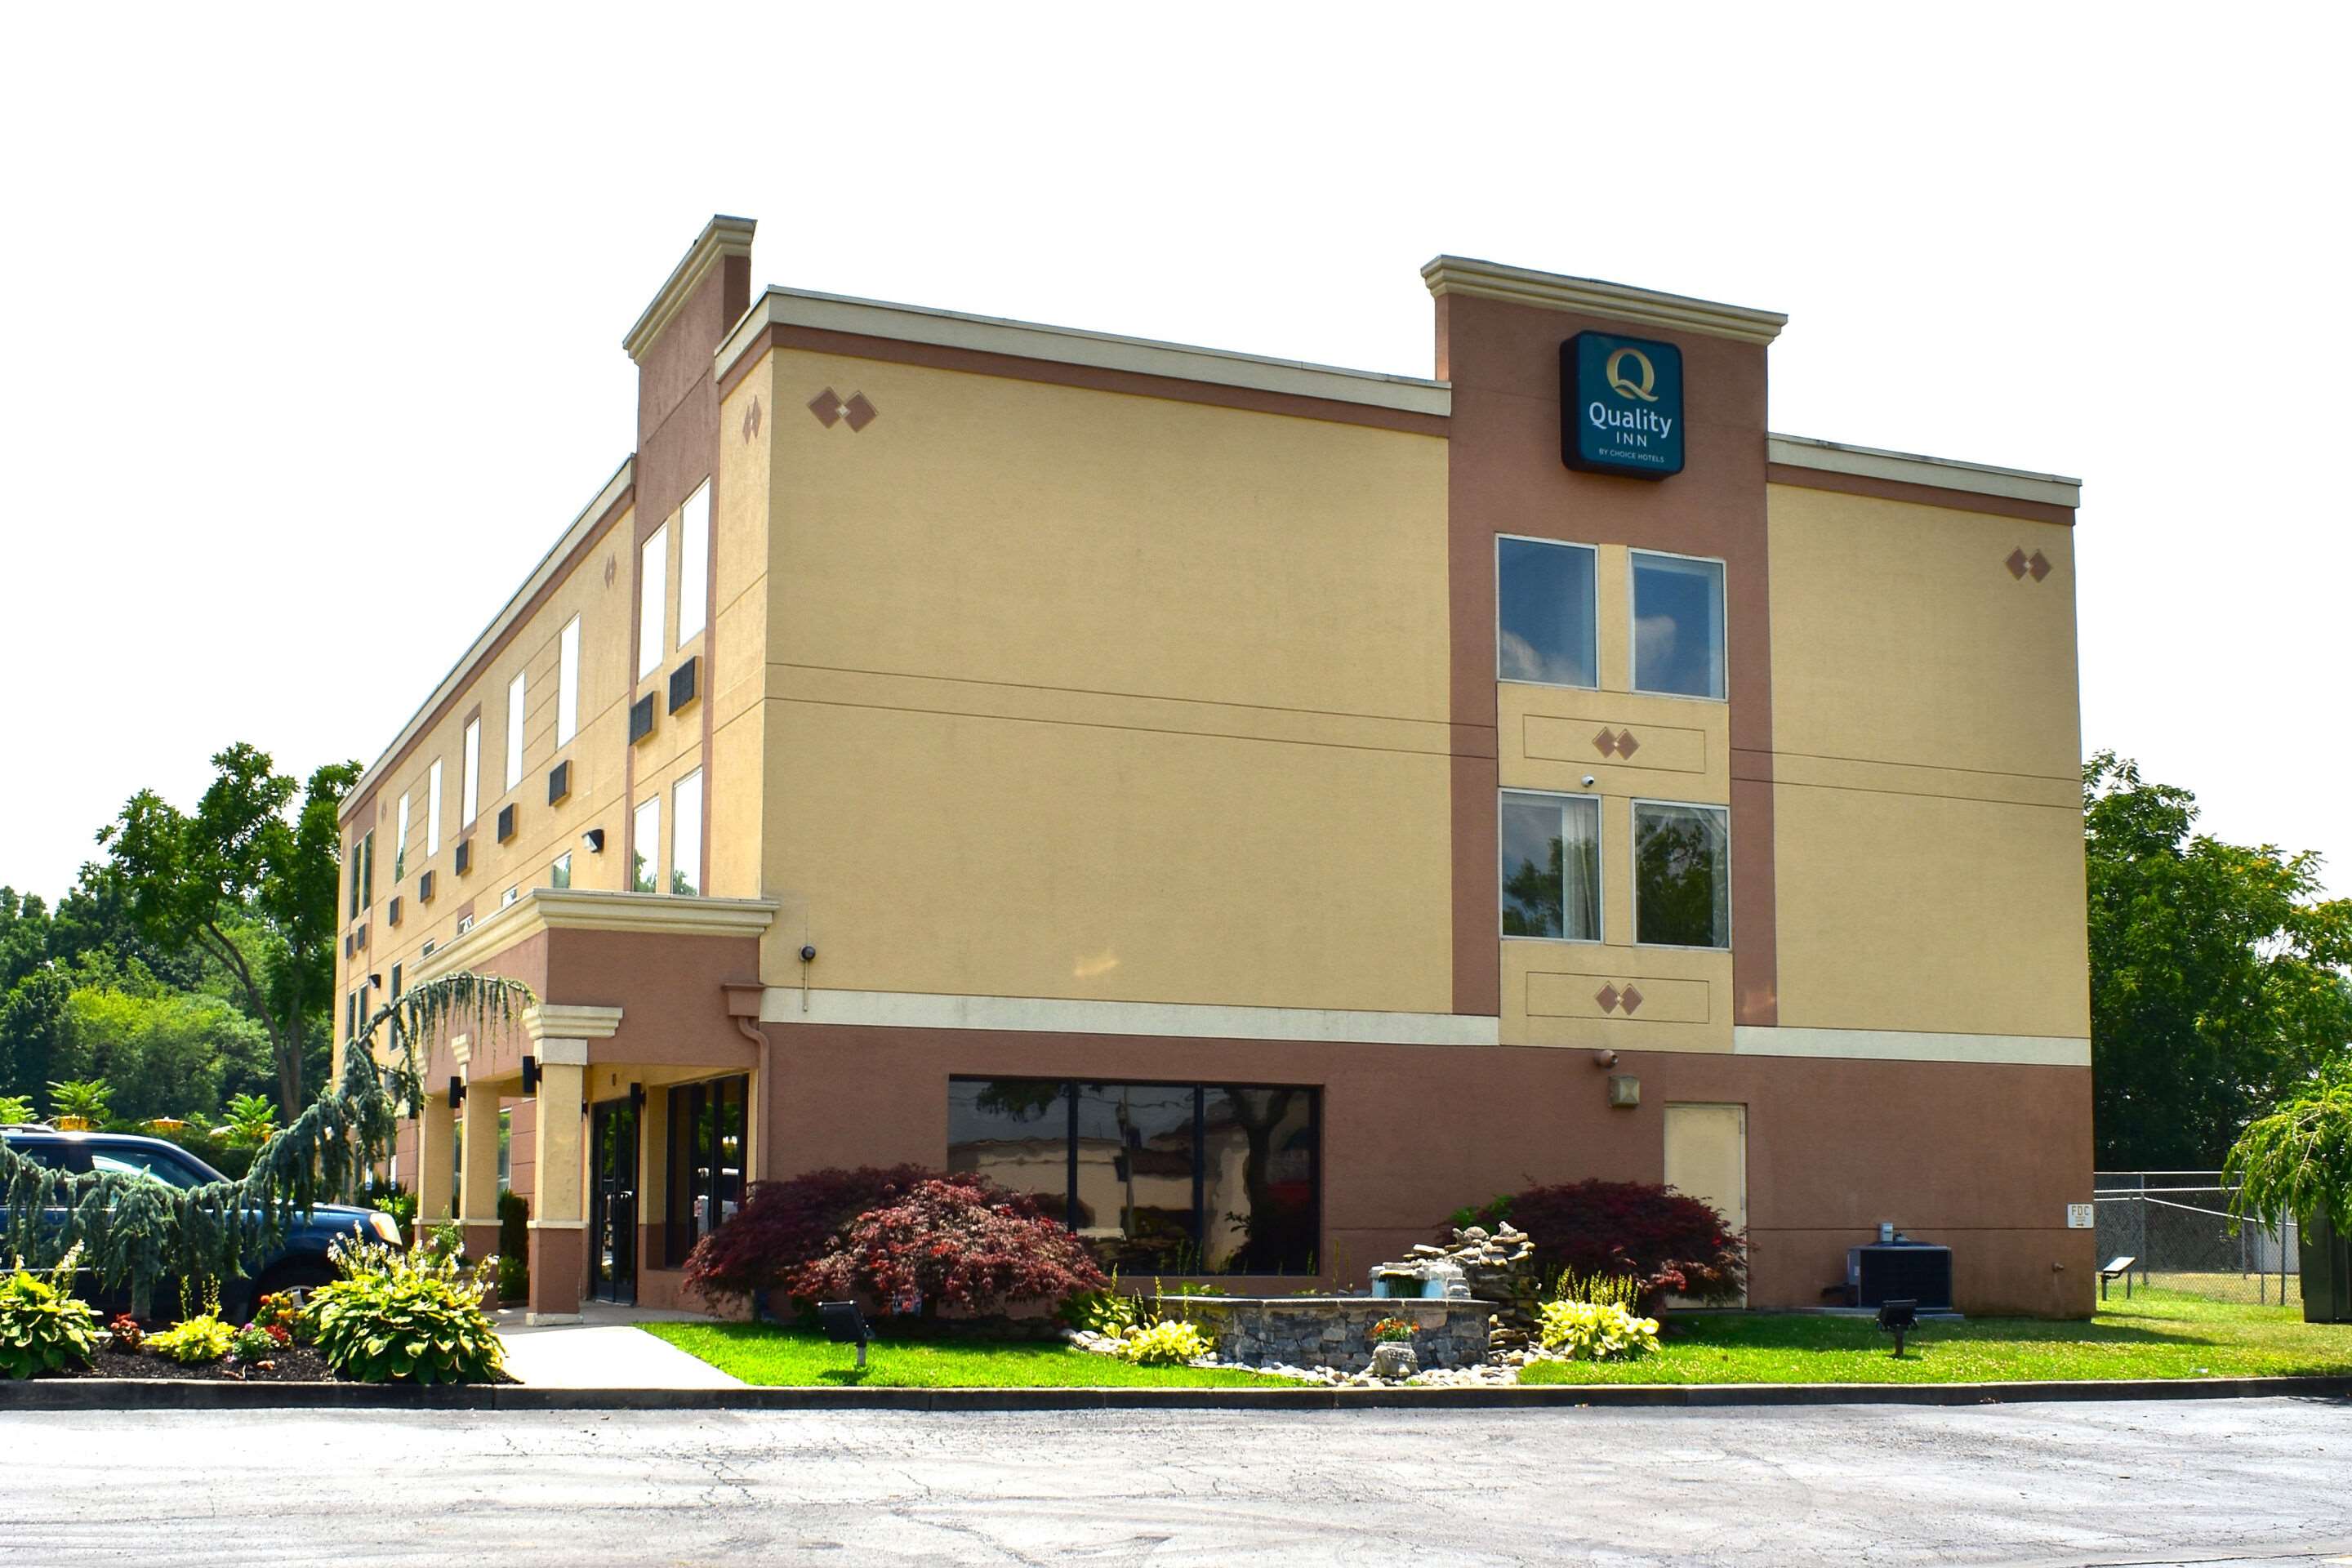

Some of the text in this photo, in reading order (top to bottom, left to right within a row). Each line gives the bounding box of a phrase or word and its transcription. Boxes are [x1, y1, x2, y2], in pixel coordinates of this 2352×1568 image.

[1606, 348, 1659, 402] Q
[1589, 402, 1672, 439] Quality
[1616, 431, 1647, 448] INN
[1610, 449, 1637, 459] CHOICE
[1637, 453, 1665, 463] HOTELS
[2071, 1205, 2090, 1216] FDC
